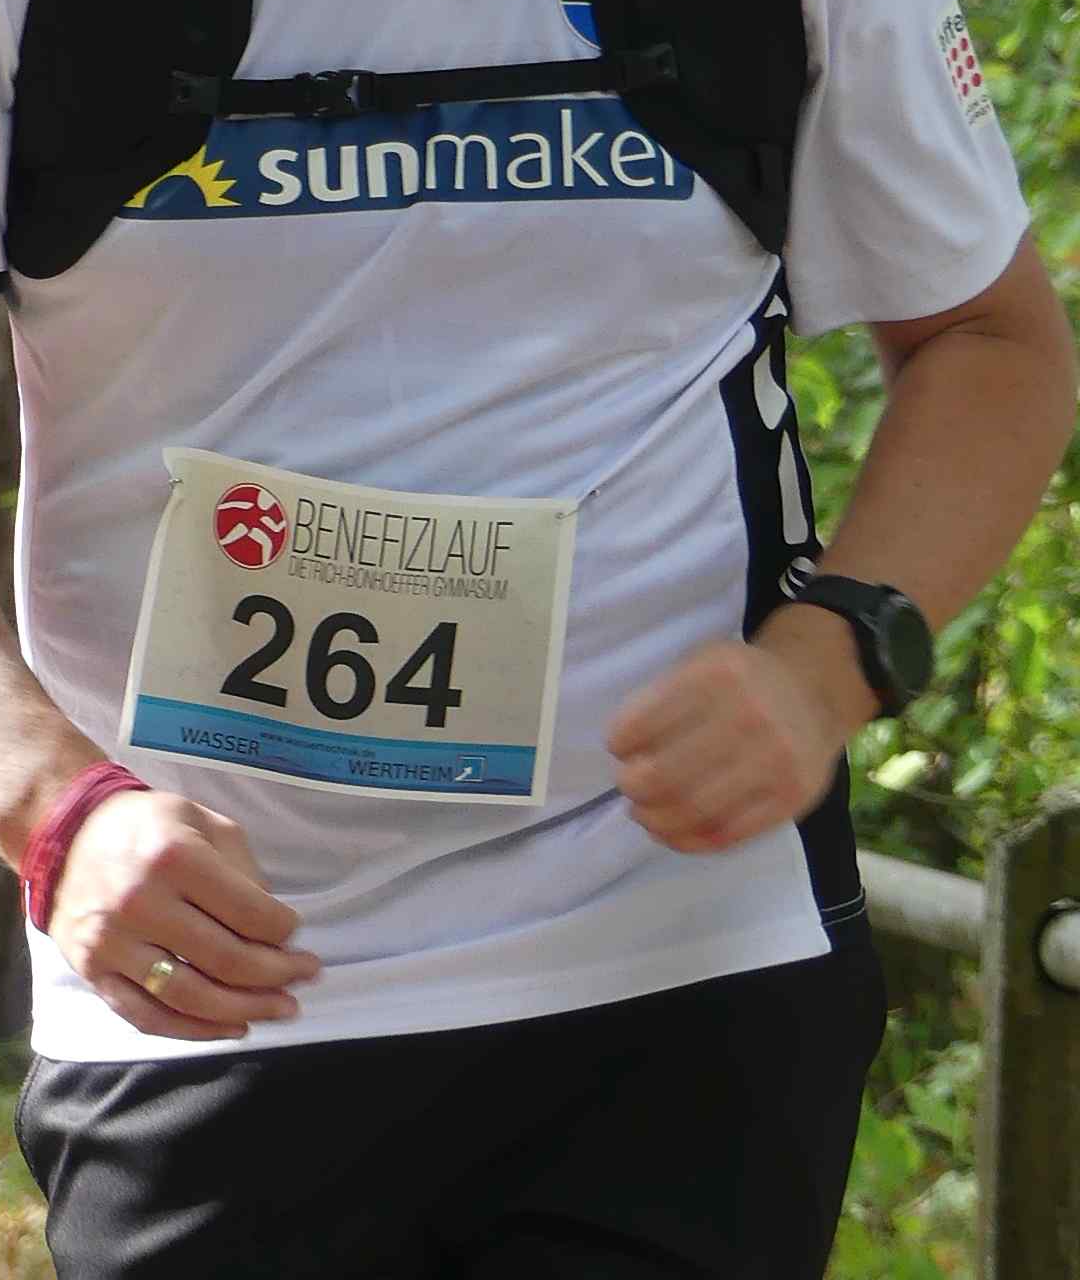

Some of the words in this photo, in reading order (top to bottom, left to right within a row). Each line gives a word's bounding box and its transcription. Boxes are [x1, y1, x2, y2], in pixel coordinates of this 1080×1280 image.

[292, 498, 513, 576] BENEFIZLAUF
[433, 575, 509, 601] GYMNASIUM
[220, 595, 462, 728] 264
[181, 726, 261, 757] WASSER
[348, 759, 453, 783] WERTHEIM
